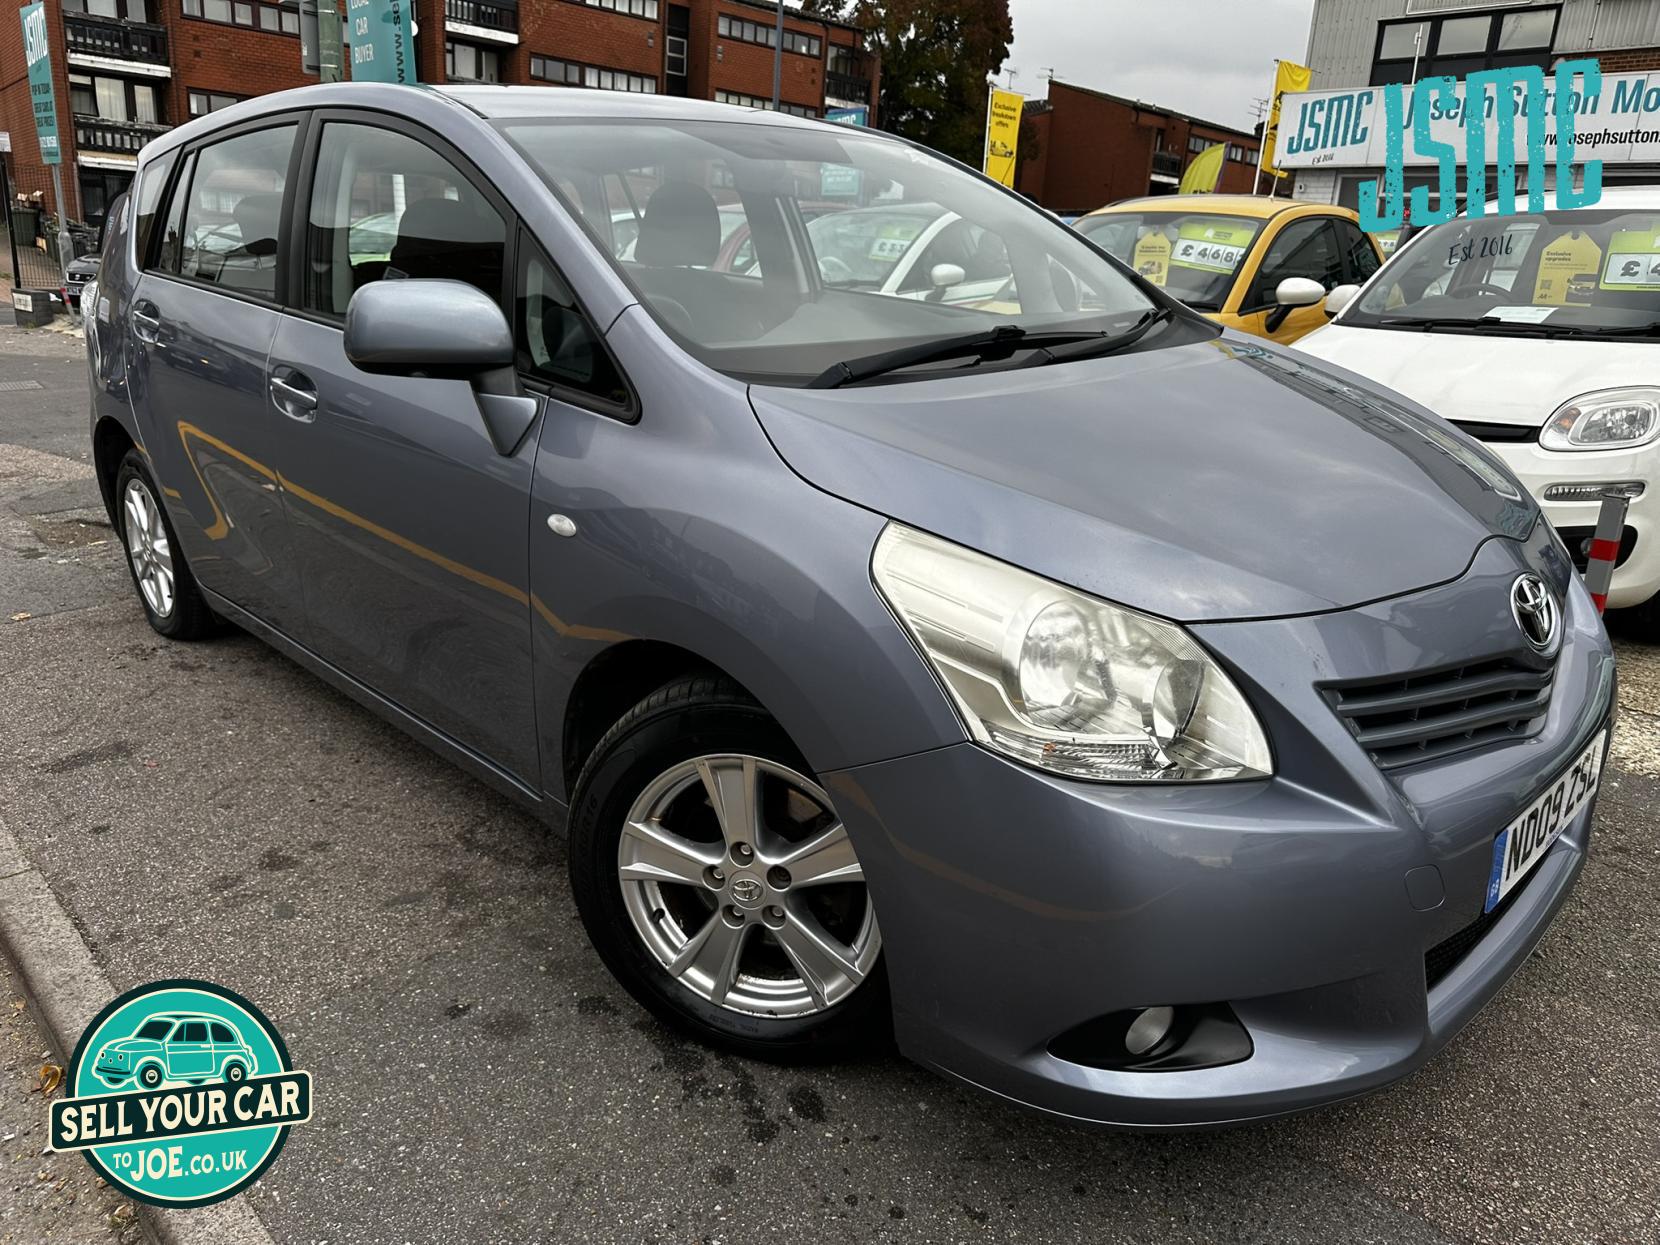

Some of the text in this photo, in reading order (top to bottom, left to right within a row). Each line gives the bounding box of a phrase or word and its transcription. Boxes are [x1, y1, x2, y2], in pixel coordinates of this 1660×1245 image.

[355, 16, 369, 36] CAR
[354, 43, 374, 64] BUYER
[1287, 91, 1373, 154] JSMC
[1403, 86, 1494, 129] Jseph
[1505, 781, 1565, 882] ND09
[1564, 745, 1597, 818] ZSL
